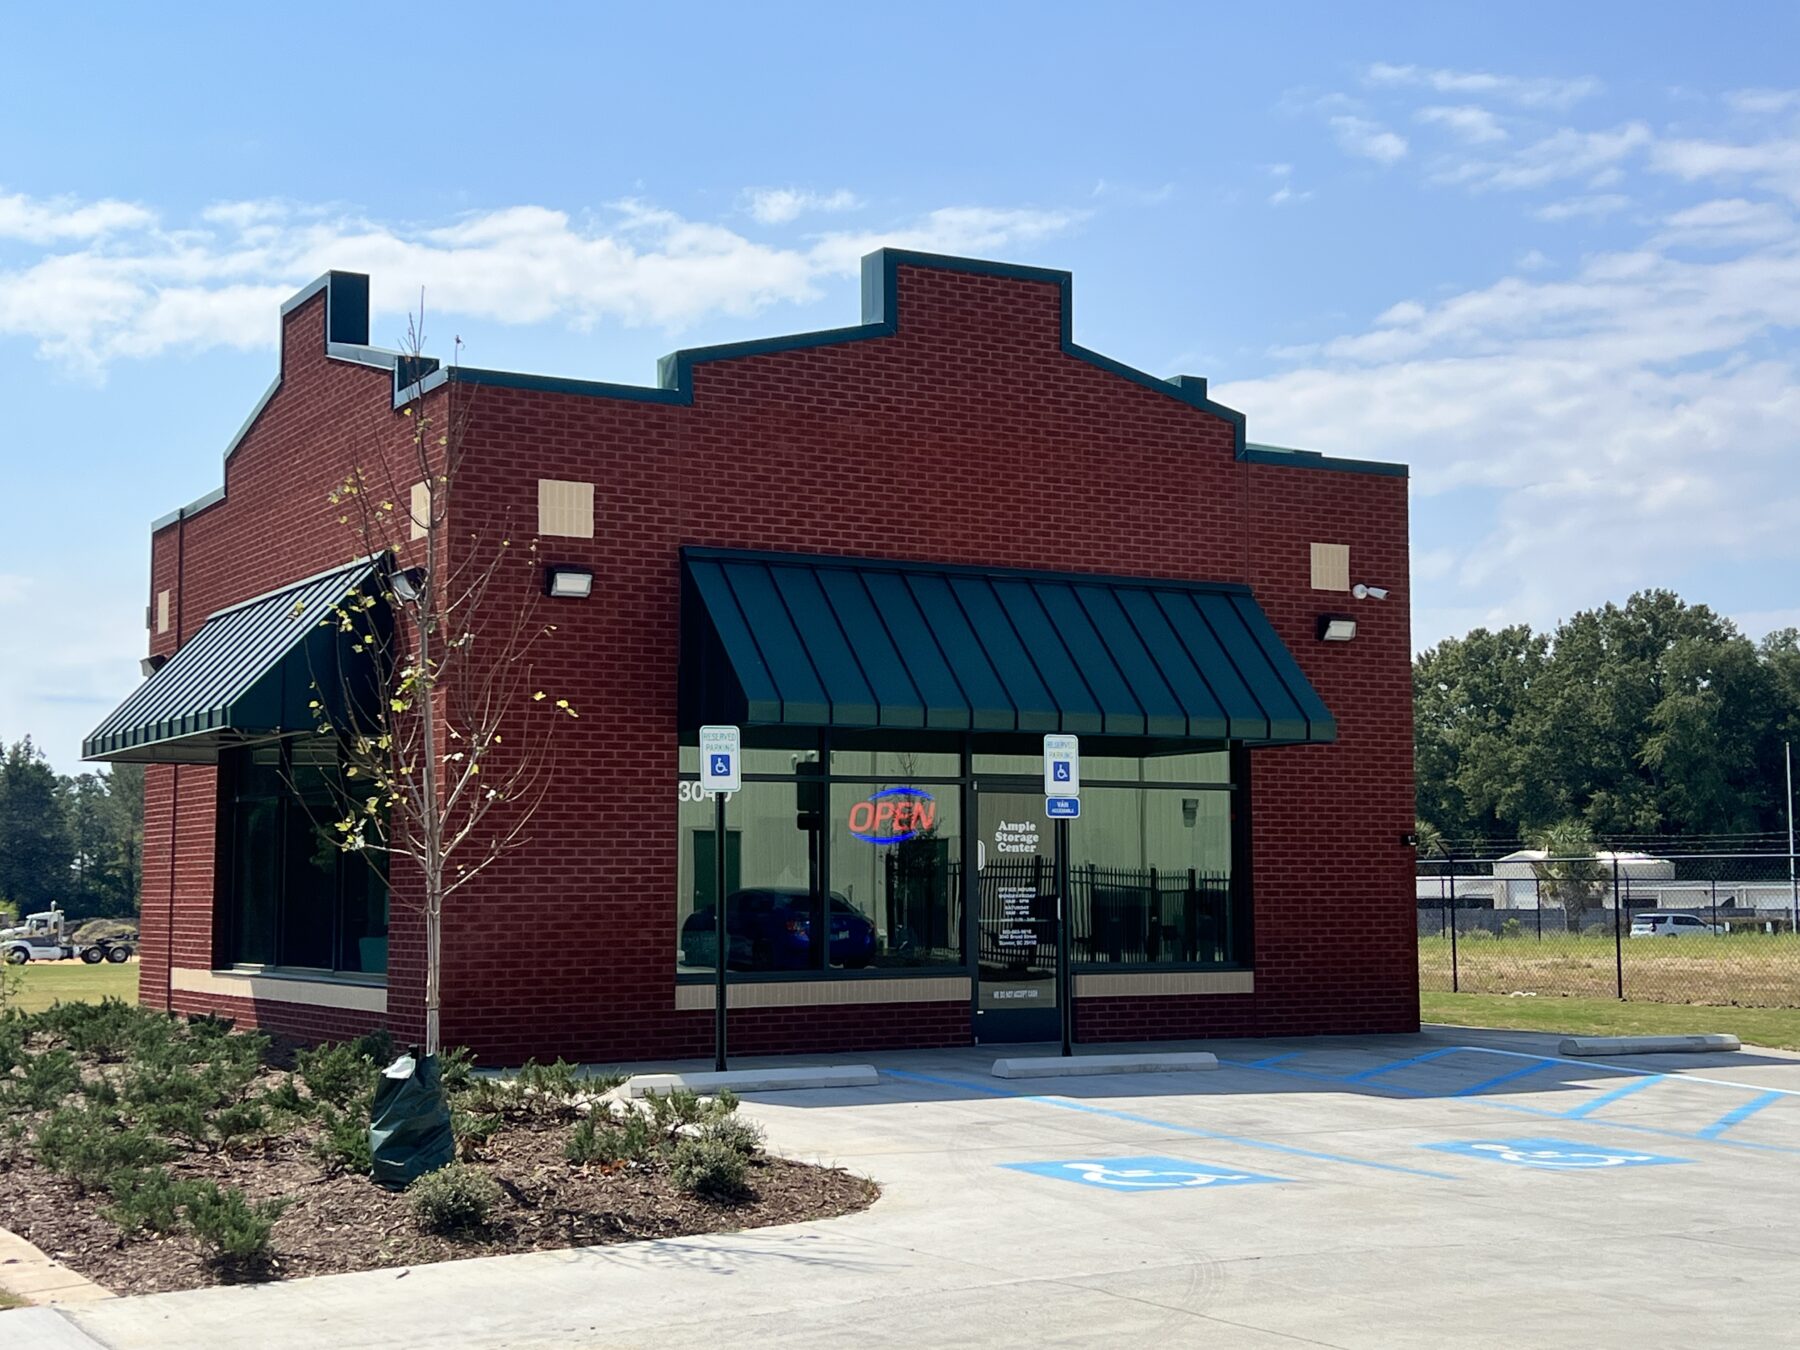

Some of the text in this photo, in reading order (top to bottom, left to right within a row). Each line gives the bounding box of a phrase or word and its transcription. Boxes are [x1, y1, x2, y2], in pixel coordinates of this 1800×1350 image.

[703, 732, 737, 741] RESERVED
[705, 743, 736, 752] PARKING
[848, 800, 936, 832] OPEN
[998, 820, 1037, 833] Ample
[995, 831, 1040, 845] Storage
[997, 842, 1037, 853] Center
